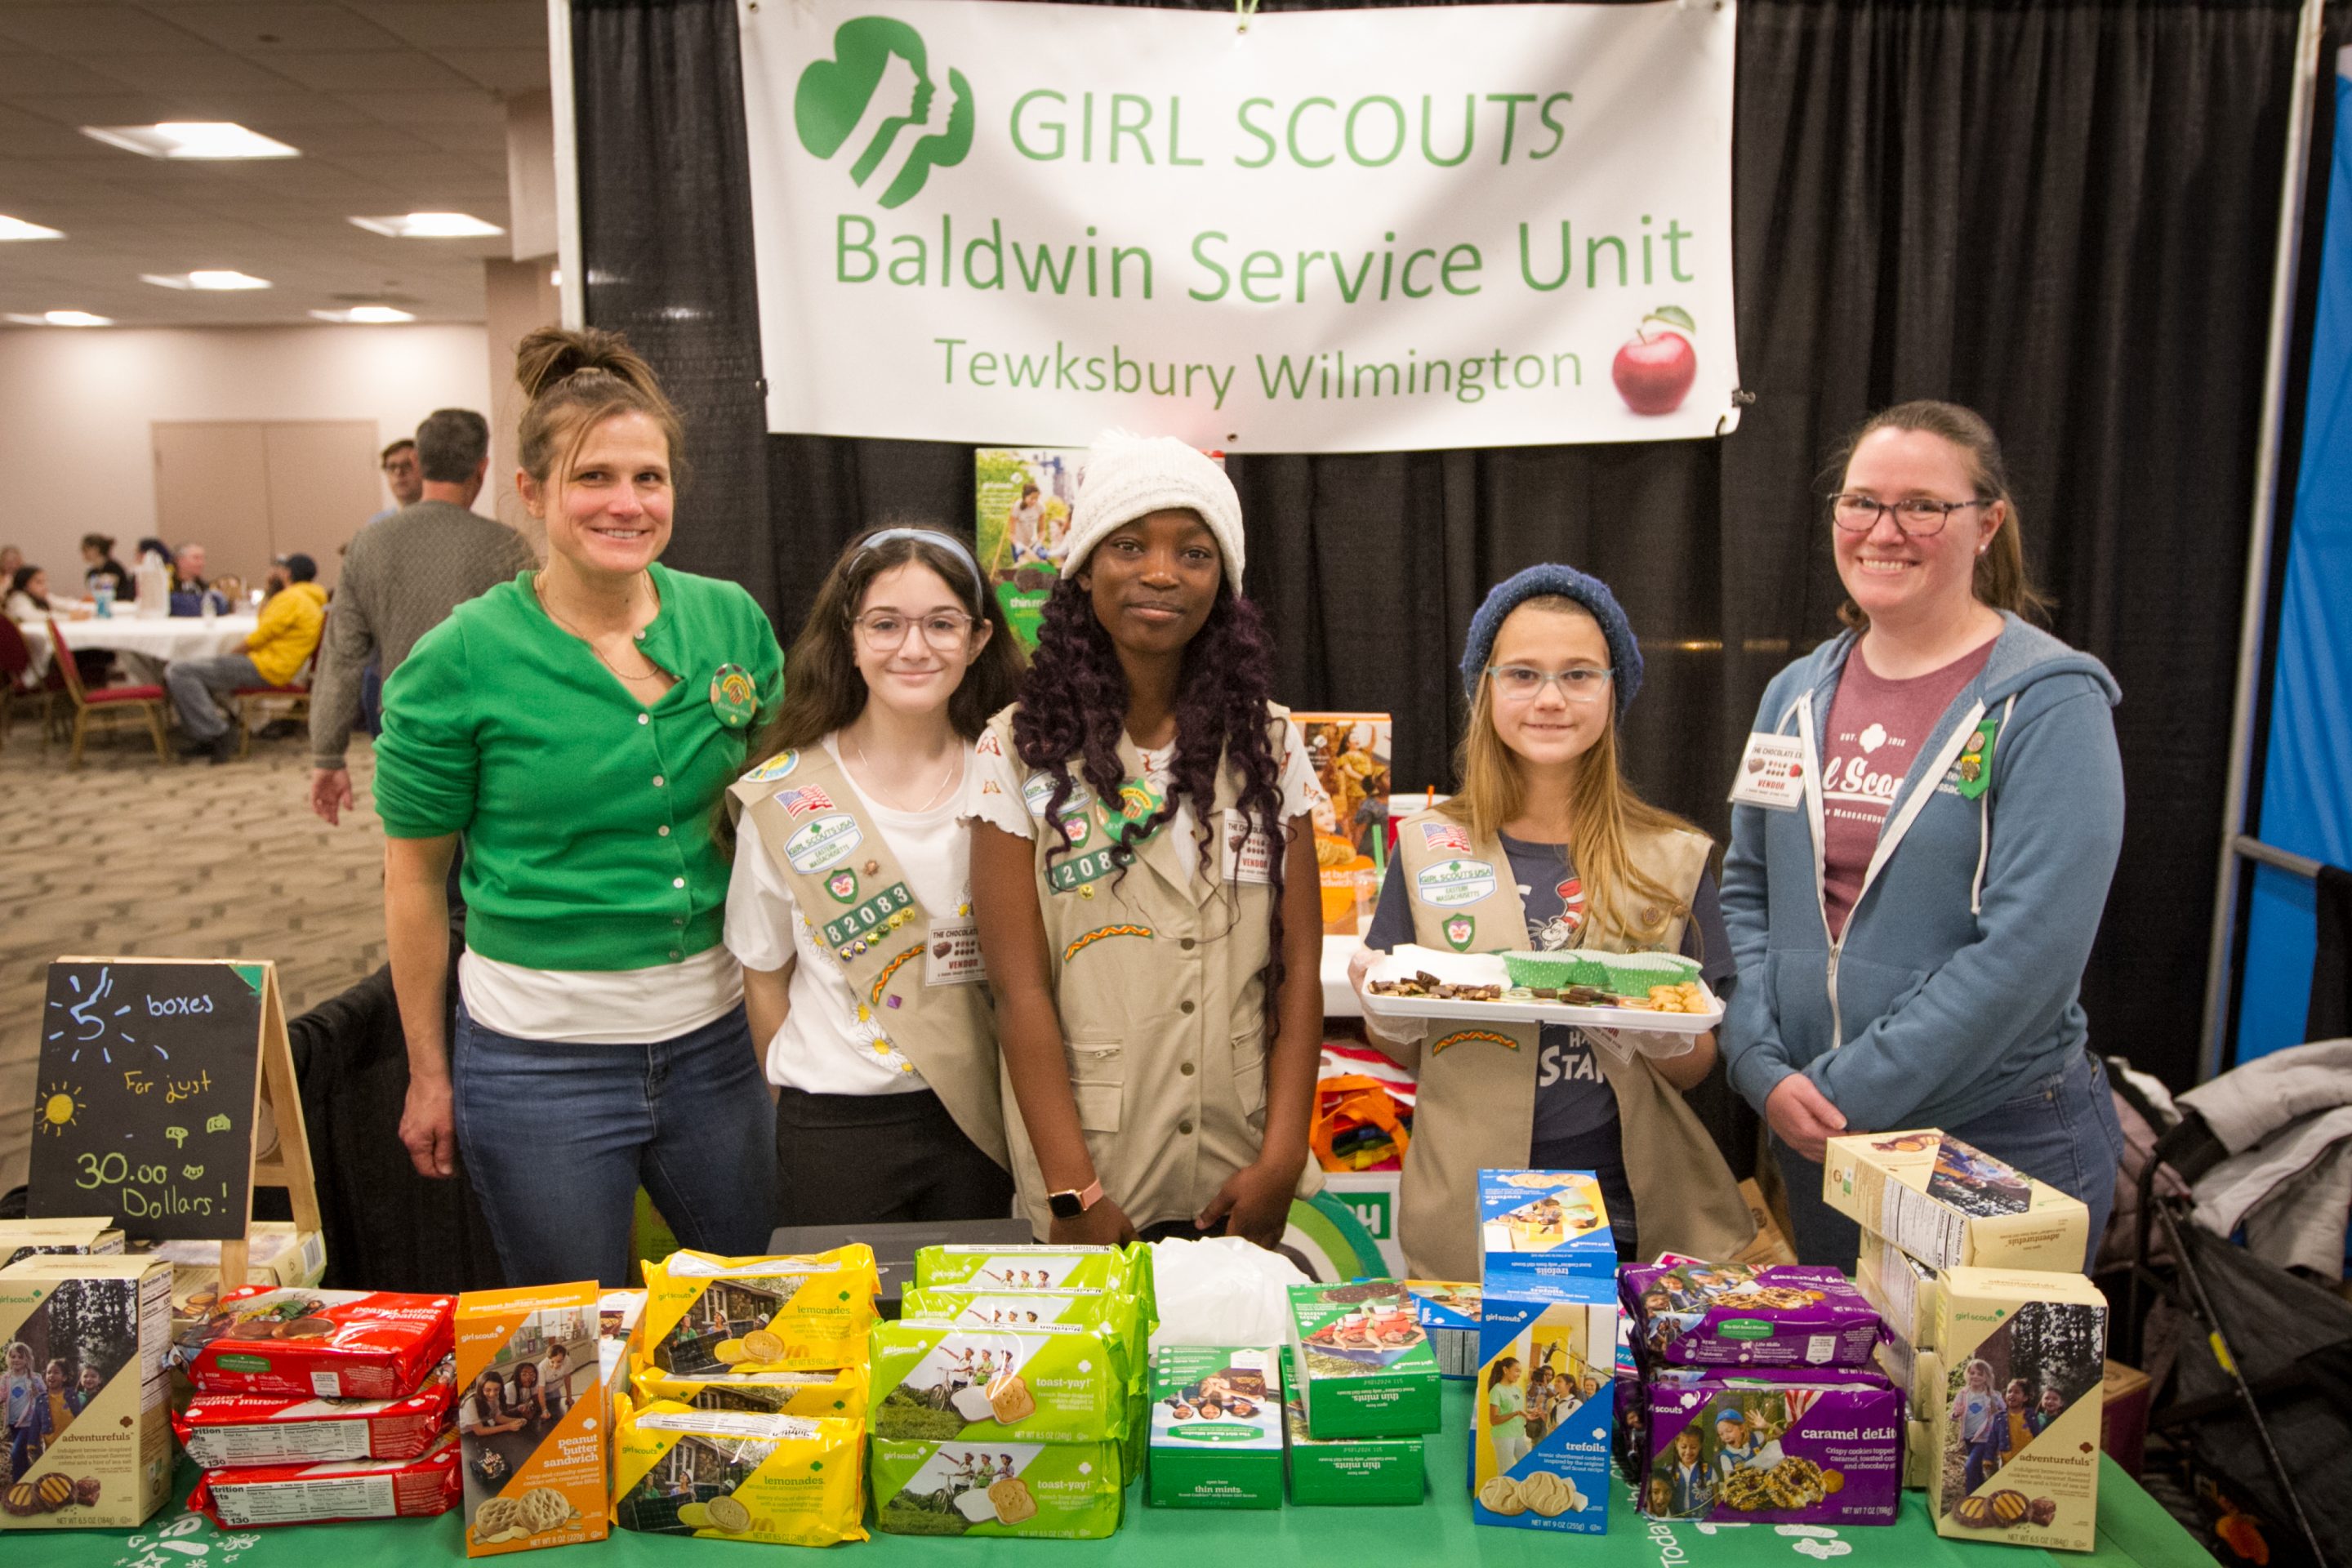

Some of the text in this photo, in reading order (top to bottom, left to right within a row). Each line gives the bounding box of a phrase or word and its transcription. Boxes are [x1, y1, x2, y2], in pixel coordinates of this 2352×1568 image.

[1009, 89, 1573, 167] GIRL SCOUTS
[835, 214, 1695, 304] Baldwin Service Unit
[935, 336, 1582, 410] Tewksbury Wilmington
[1762, 748, 1793, 757] CHOCOLATE
[1758, 779, 1785, 789] VENDOR
[789, 820, 853, 854] GIRL SCOUTS USA
[815, 843, 836, 858] EASTERN
[1242, 858, 1267, 868] VENDOR
[1441, 871, 1473, 880] SCOUTS
[1321, 879, 1353, 887] ndwich
[1446, 885, 1468, 893] EASTERN
[1437, 892, 1480, 902] MASSACHUSETTS
[826, 886, 909, 943] 82083
[947, 928, 978, 938] CHOCOLAT
[949, 959, 978, 969] VENDOR
[69, 967, 213, 1040] 5 boxes
[124, 1070, 212, 1103] For just
[76, 1152, 167, 1188] 30.00
[2008, 1233, 2060, 1246] adventurefuls
[142, 1277, 160, 1288] Nutrition
[1771, 1274, 1821, 1282] caramel
[658, 1293, 670, 1301] girl
[797, 1306, 850, 1315] lemonades
[1955, 1312, 1970, 1321] girl
[461, 1334, 474, 1343] girl
[1036, 1378, 1089, 1390] toast-yay!
[1353, 1392, 1400, 1402] thin mints
[1655, 1406, 1683, 1414] scouts
[62, 1432, 131, 1442] adventurefuls
[1036, 1431, 1045, 1439] 8.5
[1046, 1431, 1054, 1439] OZ
[1802, 1428, 1859, 1440] caramel
[558, 1434, 598, 1449] peanut
[564, 1445, 598, 1455] butter
[621, 1446, 634, 1454] girl
[1566, 1442, 1606, 1452] trefoils
[544, 1453, 599, 1468] sandwich
[884, 1452, 920, 1461] girl scouts
[2020, 1454, 2090, 1466] adventurefuls
[1335, 1461, 1381, 1470] thin mints
[764, 1475, 823, 1486] lemonades
[1037, 1480, 1090, 1492] toast-yay!
